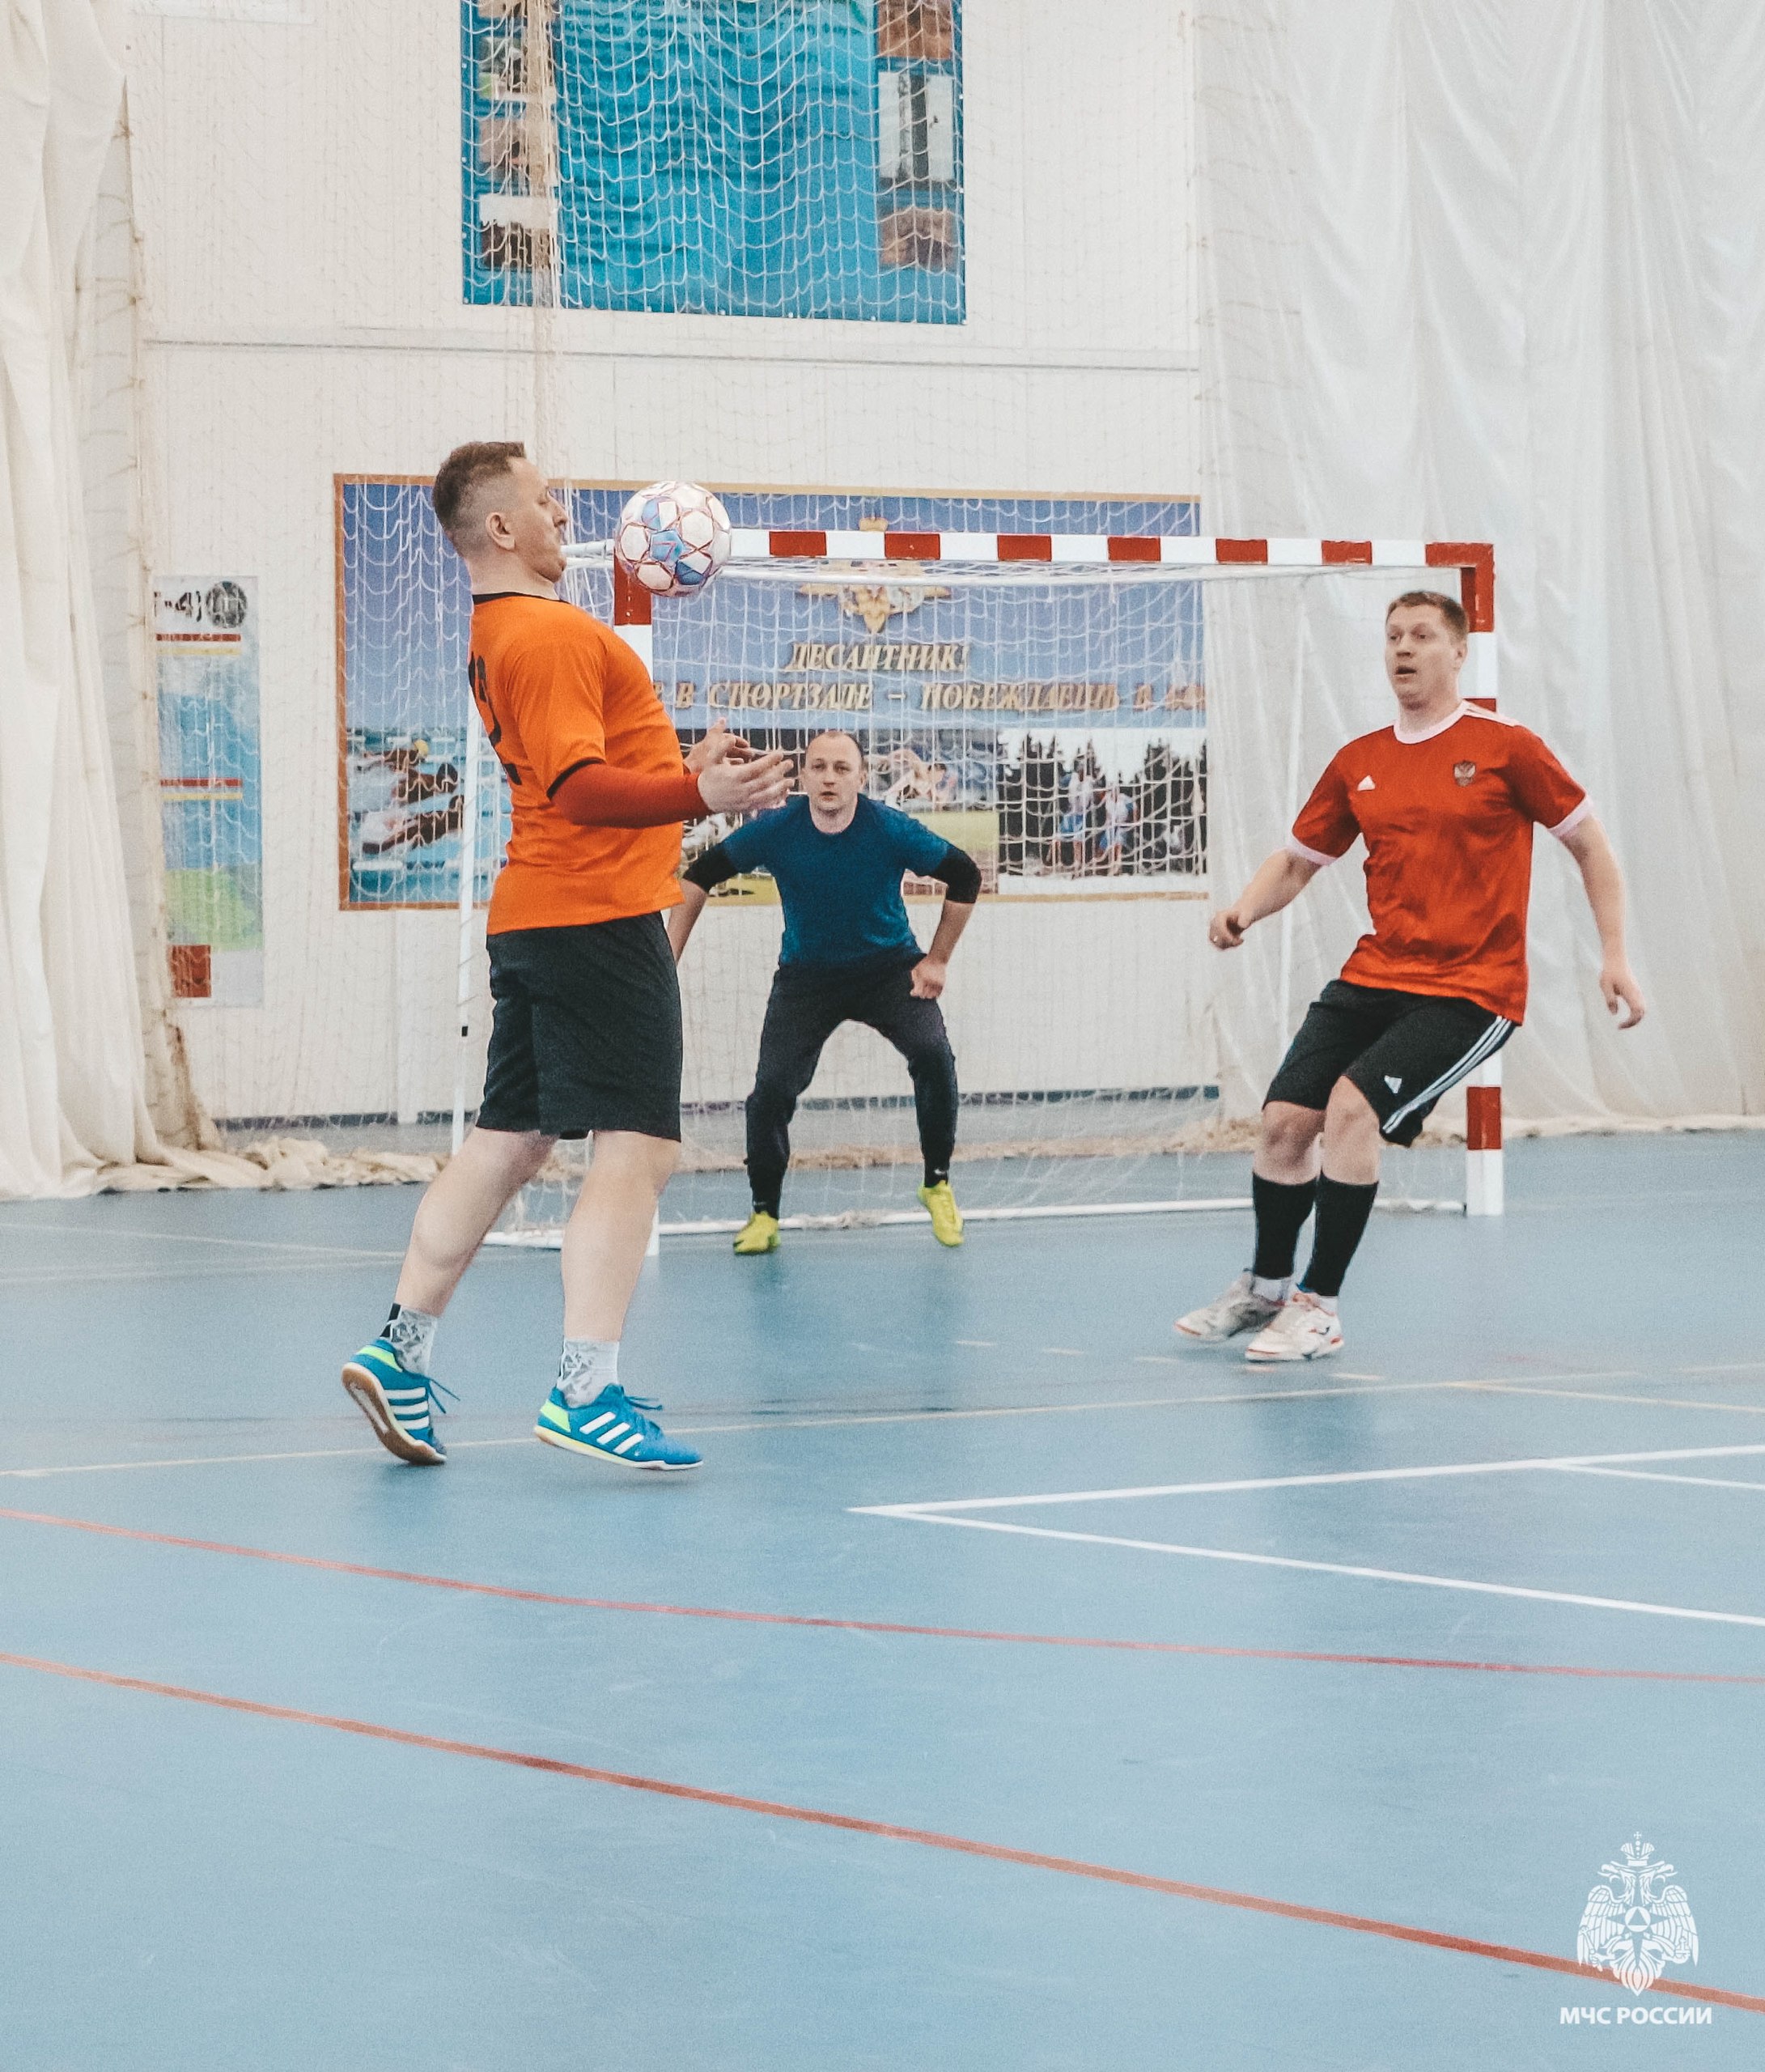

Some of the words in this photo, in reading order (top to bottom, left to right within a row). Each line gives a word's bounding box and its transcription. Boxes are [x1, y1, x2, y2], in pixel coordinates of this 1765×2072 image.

[783, 643, 969, 672] ДЕСАНТНИК!
[675, 681, 695, 708] В
[709, 681, 873, 710] СПОРТЗАЛЕ
